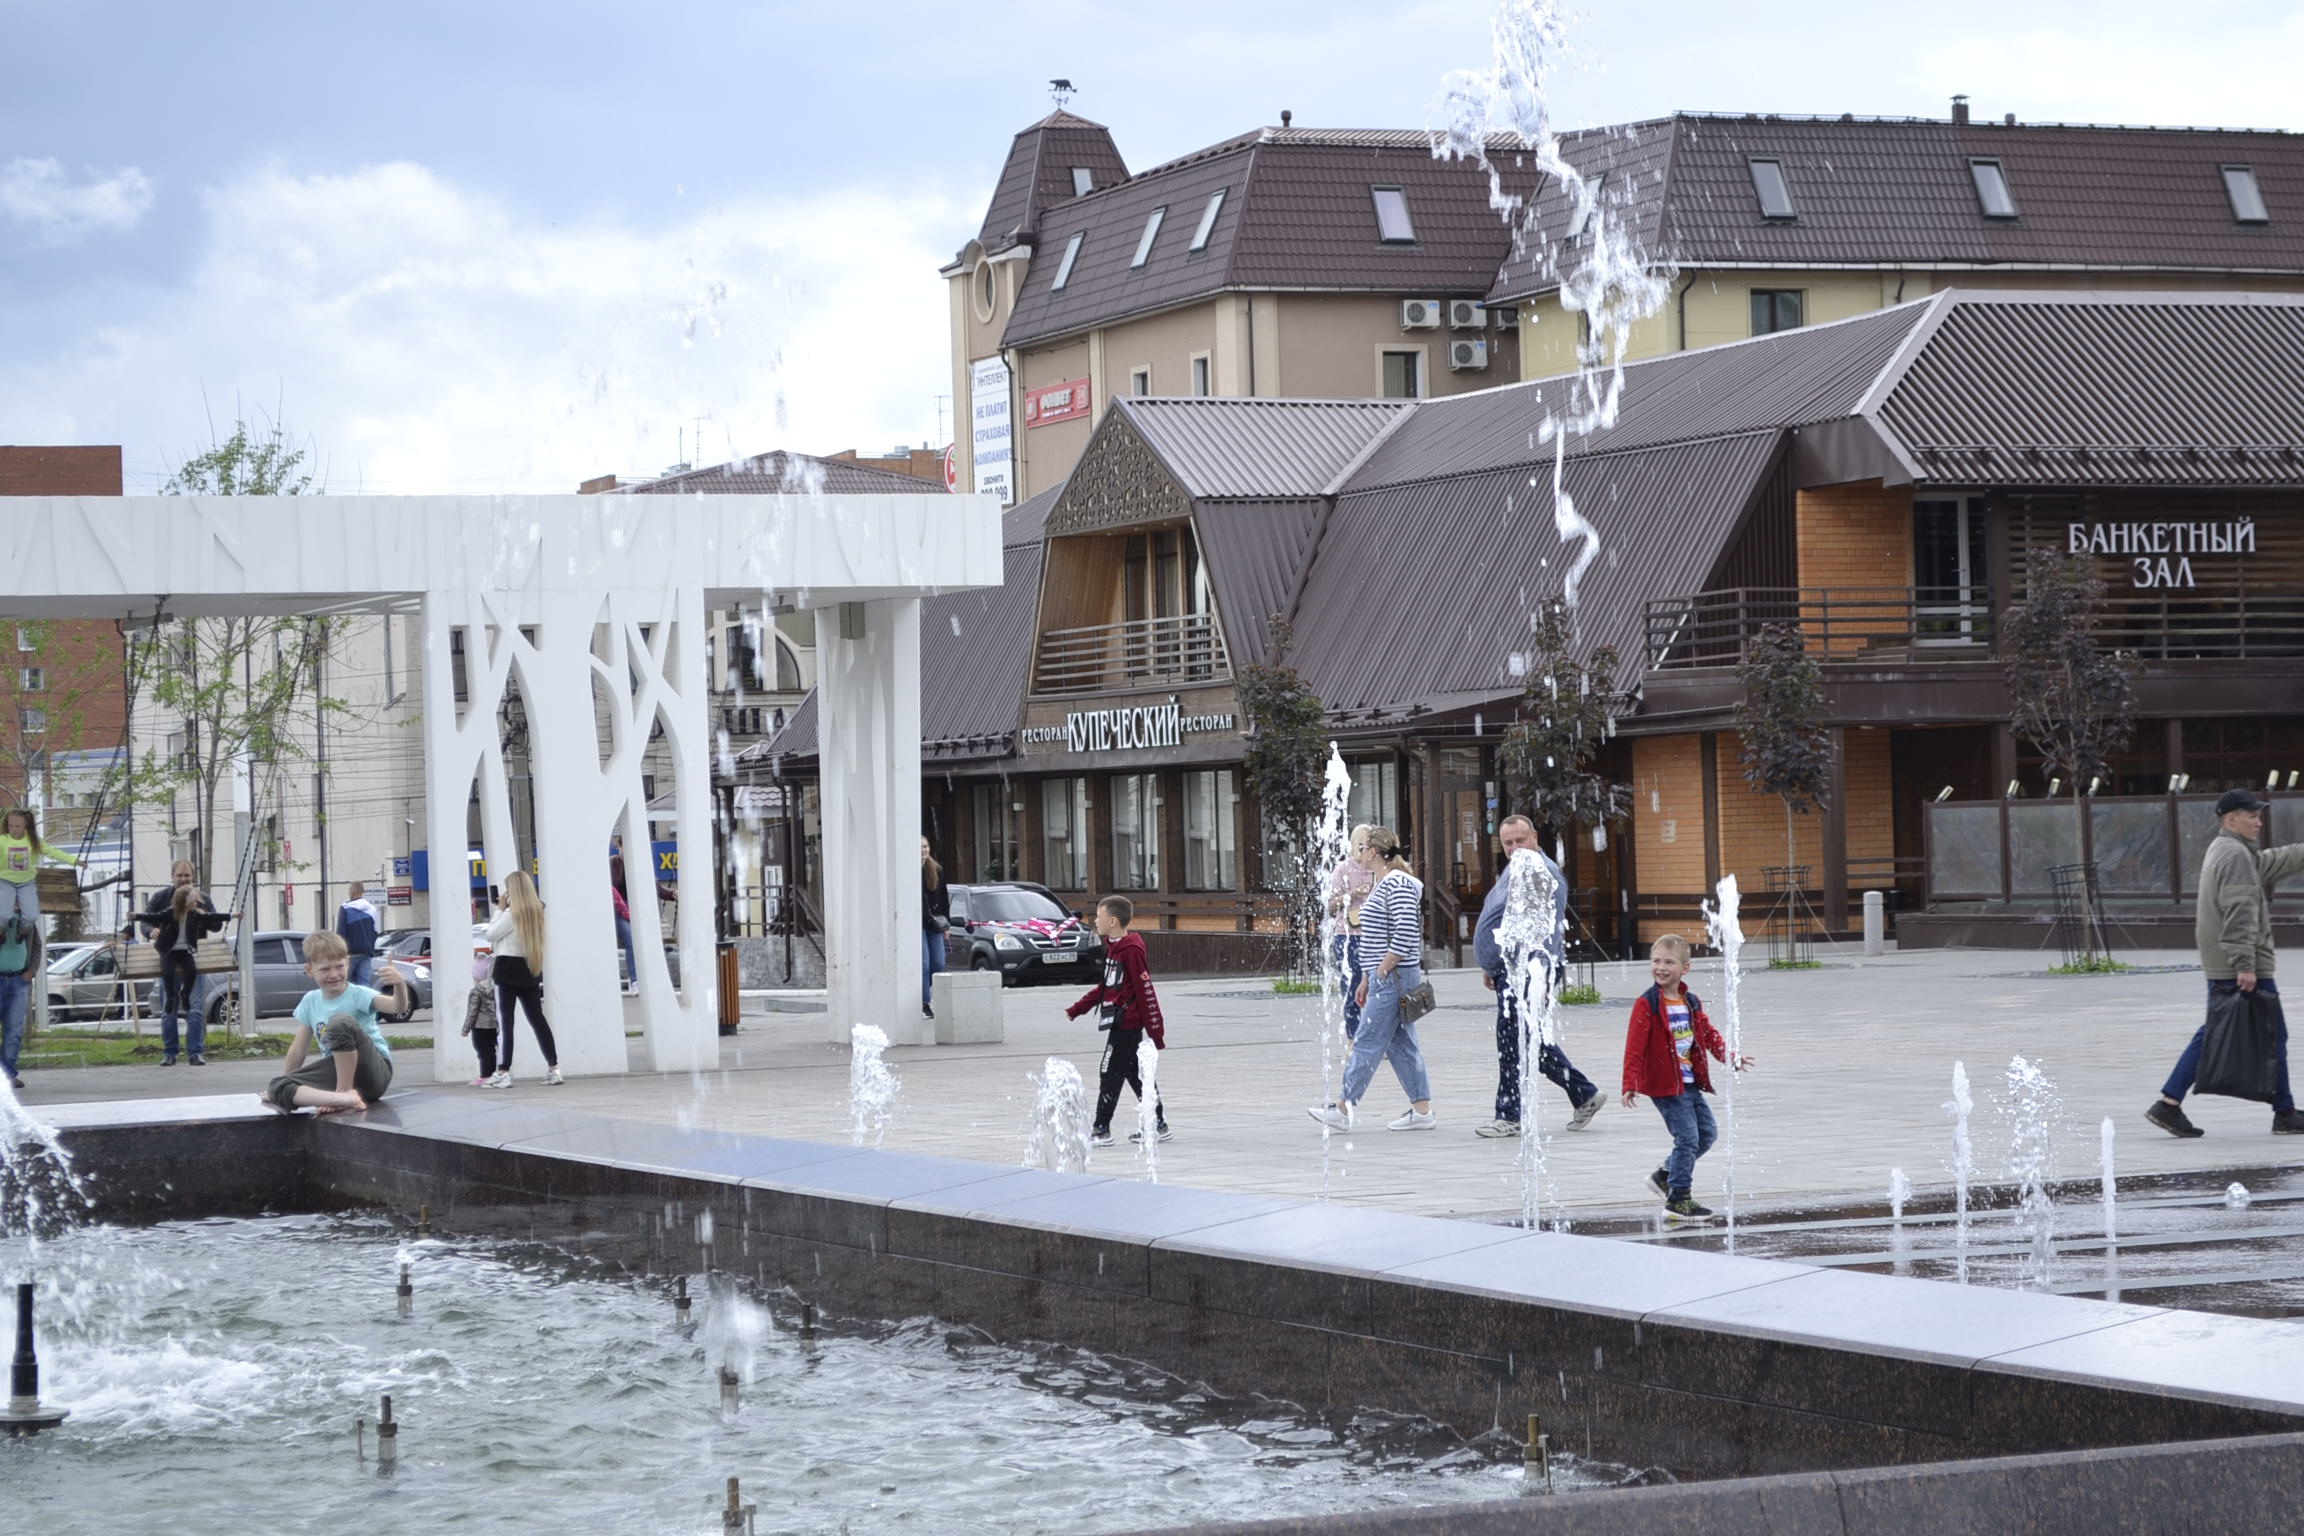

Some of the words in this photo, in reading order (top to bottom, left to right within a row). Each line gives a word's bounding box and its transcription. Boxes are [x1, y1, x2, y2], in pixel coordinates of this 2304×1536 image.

[976, 406, 985, 419] НЕ
[985, 400, 1007, 417] ПЛАТИТ
[975, 424, 1010, 442] СТРАХОВАЯ
[2068, 516, 2256, 553] БАНКЕТНЫЙ
[2133, 557, 2196, 588] ЗАЛ
[1022, 726, 1067, 743] РЕСТОРАН
[1067, 694, 1181, 752] КУПЕЧЕСКИЙ
[1180, 714, 1233, 732] РЕСТОРАН
